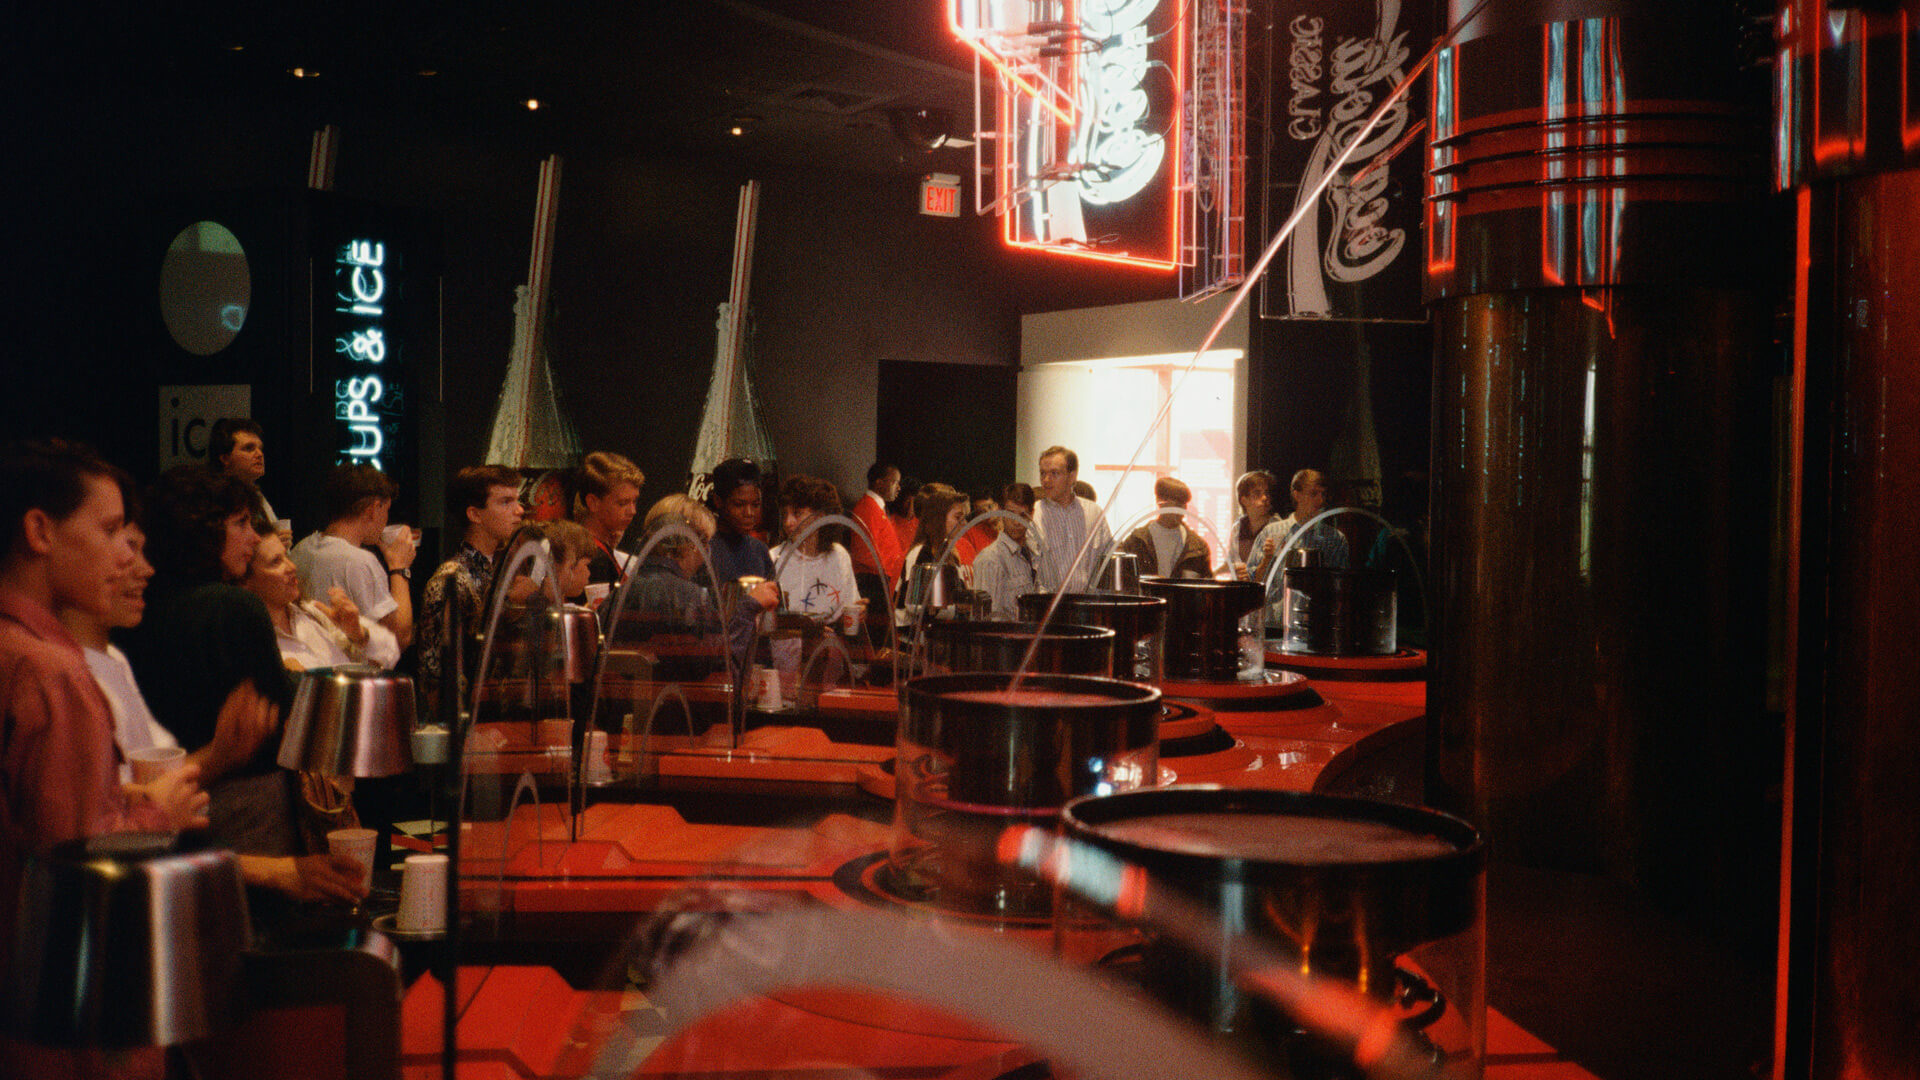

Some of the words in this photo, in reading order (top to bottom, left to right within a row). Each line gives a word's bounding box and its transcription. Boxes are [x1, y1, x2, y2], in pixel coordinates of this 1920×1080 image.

[926, 185, 957, 213] EXIT
[352, 240, 384, 315] ICE
[352, 328, 385, 362] &
